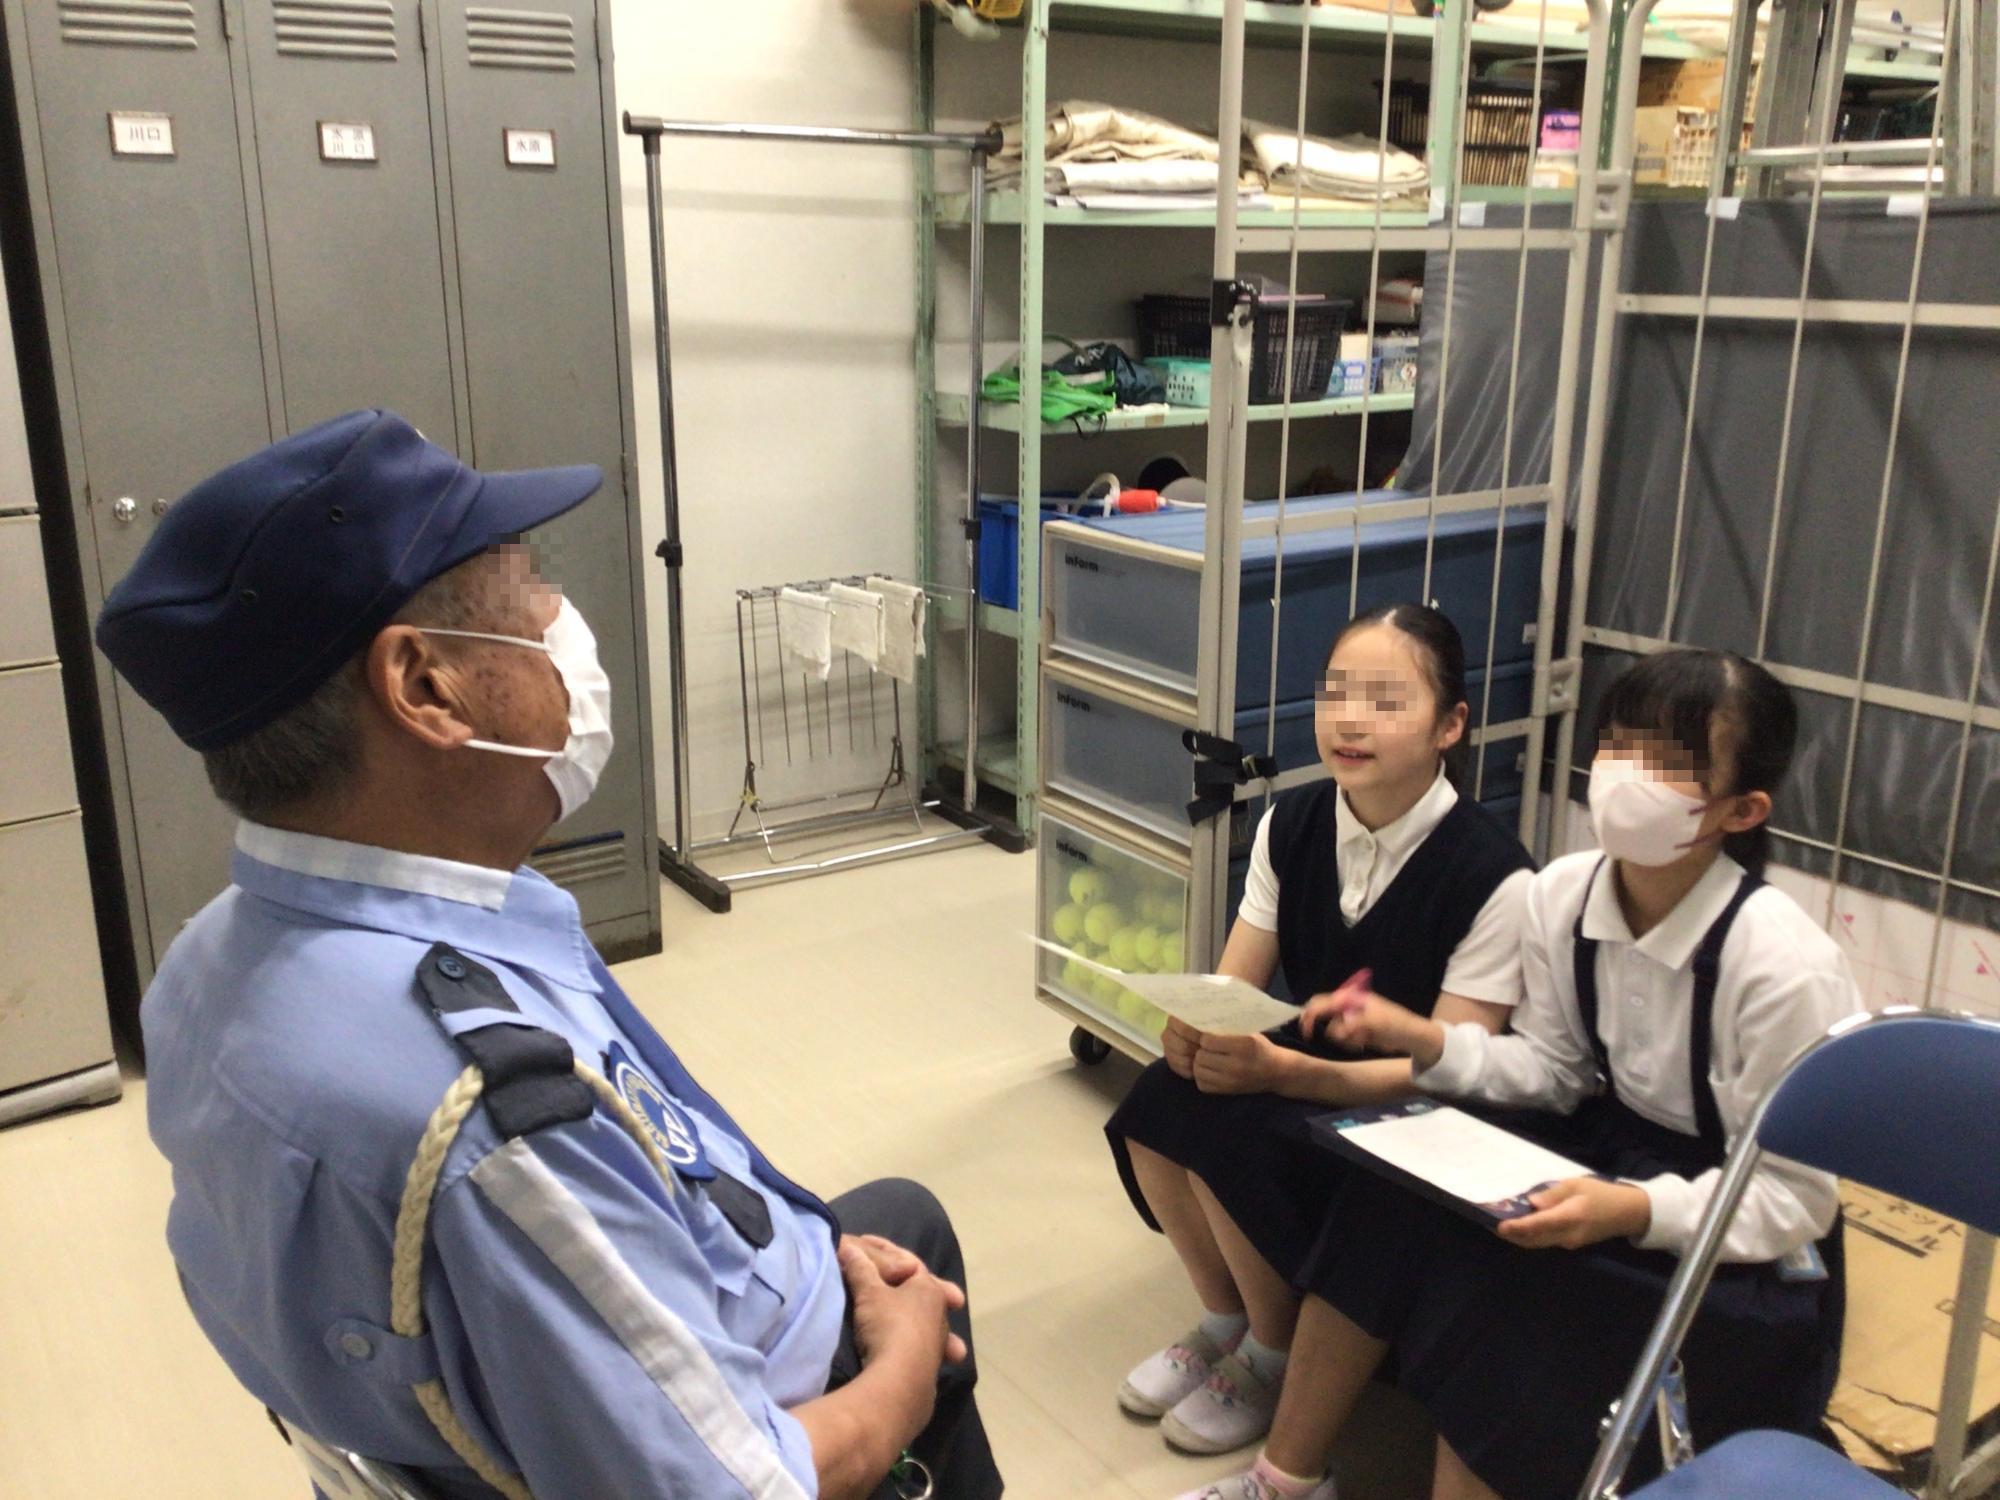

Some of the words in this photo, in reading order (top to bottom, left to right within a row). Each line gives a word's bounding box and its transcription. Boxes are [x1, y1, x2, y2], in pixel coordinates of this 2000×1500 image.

[129, 125, 162, 142] 川口
[1064, 553, 1099, 573] inform
[1057, 690, 1091, 713] inform
[1055, 839, 1088, 863] inform
